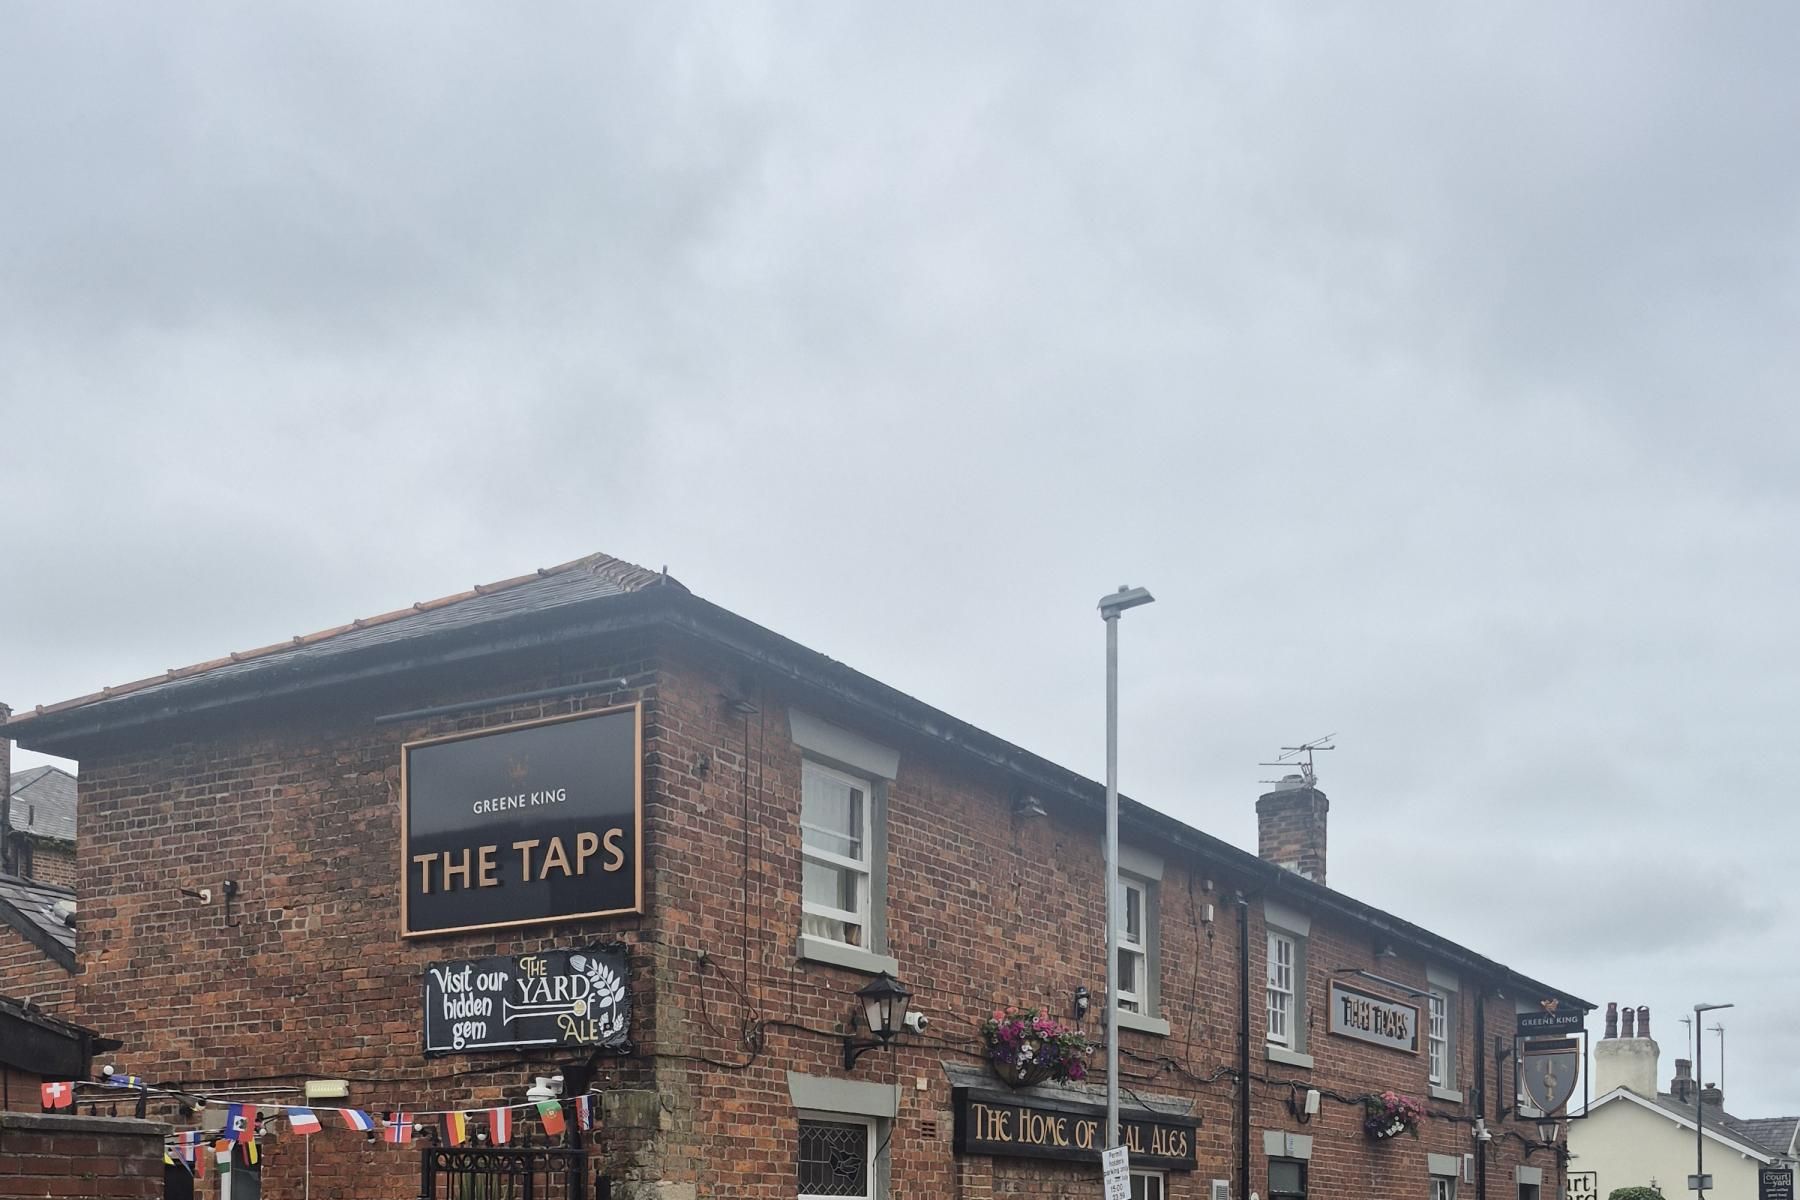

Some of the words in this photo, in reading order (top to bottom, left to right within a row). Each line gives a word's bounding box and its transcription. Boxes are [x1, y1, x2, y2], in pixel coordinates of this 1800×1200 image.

[473, 794, 526, 815] GREENE
[531, 788, 567, 806] KING
[413, 845, 498, 894] THE
[512, 828, 625, 882] TAPS
[430, 965, 472, 994] Visit
[477, 971, 509, 992] our
[520, 956, 548, 978] THE
[516, 974, 591, 1004] YARD
[443, 992, 492, 1020] hidden
[1521, 1017, 1554, 1026] GREENE
[1556, 1015, 1578, 1024] KING
[452, 1020, 487, 1050] gem
[557, 1013, 599, 1044] ALE
[971, 1103, 1013, 1141] THE
[1018, 1108, 1069, 1146] HOME
[1075, 1119, 1098, 1149] OF
[1105, 1119, 1145, 1153] AL
[1151, 1124, 1188, 1157] ALES
